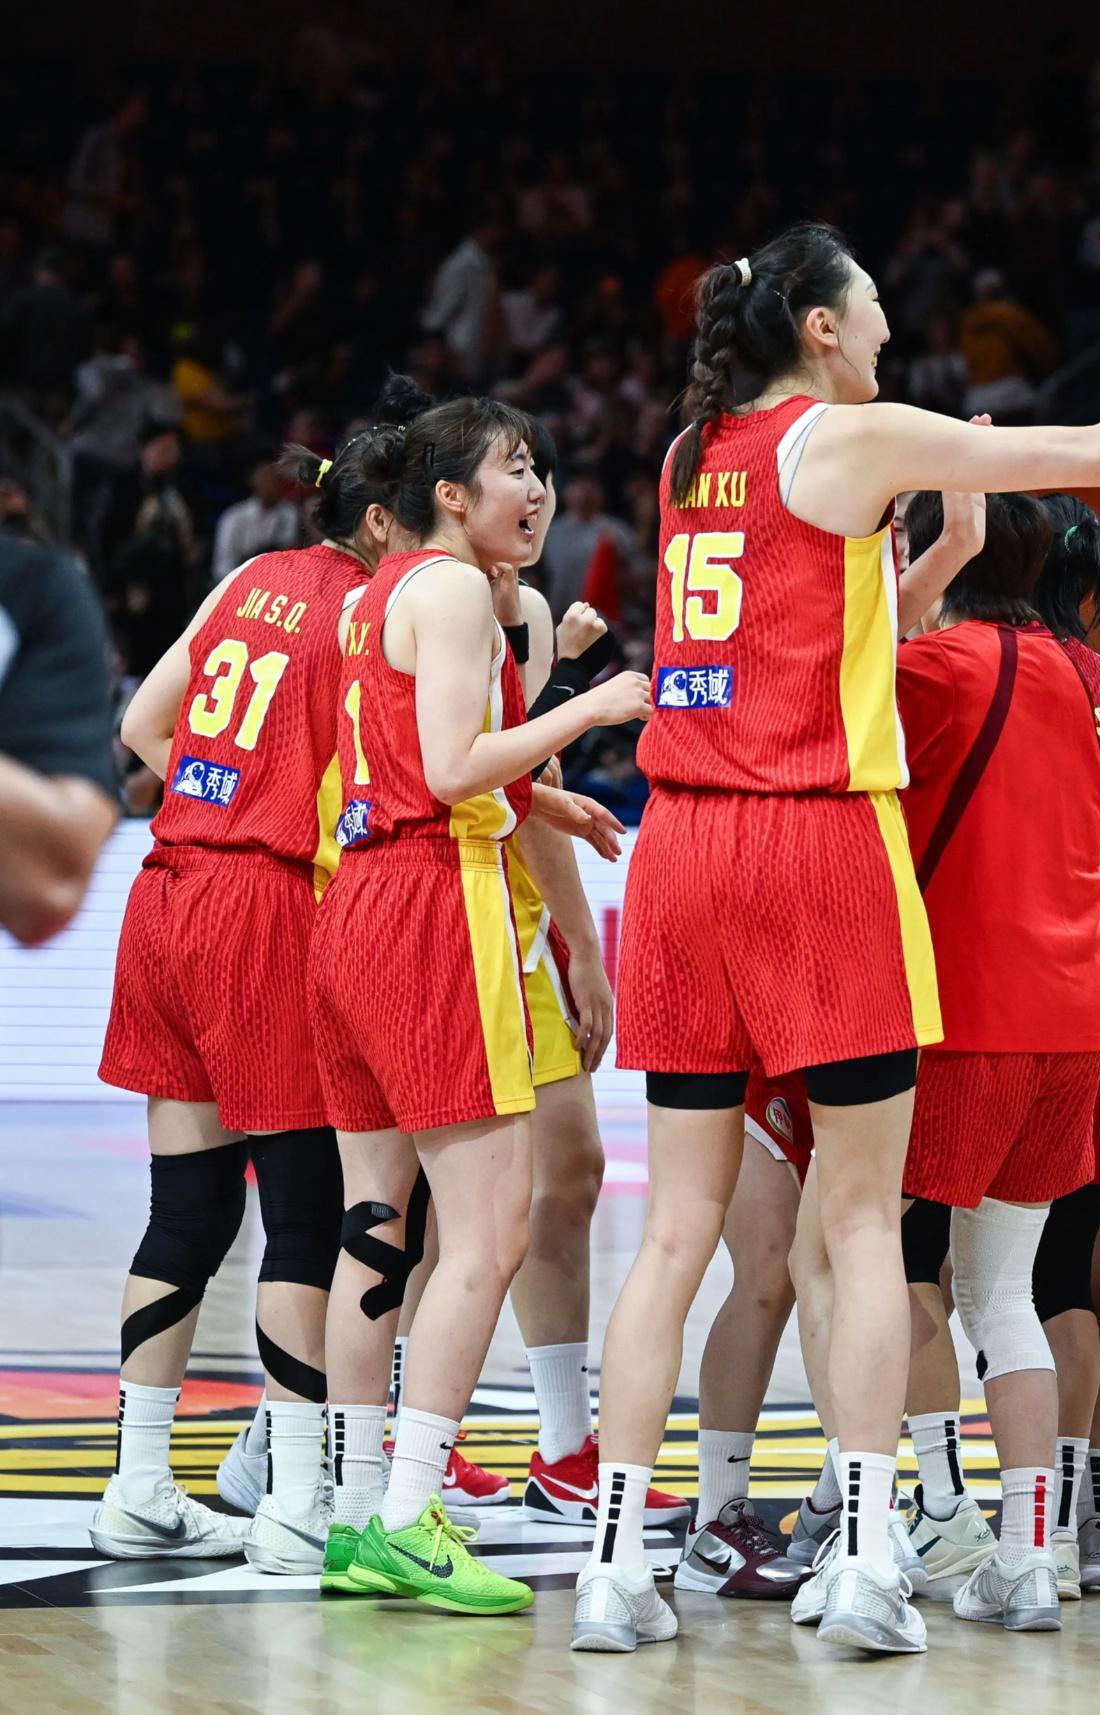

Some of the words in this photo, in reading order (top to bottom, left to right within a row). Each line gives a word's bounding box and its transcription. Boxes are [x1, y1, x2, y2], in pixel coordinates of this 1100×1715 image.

[715, 471, 747, 507] XU
[664, 531, 744, 642] 15
[236, 587, 271, 619] JIA
[264, 594, 307, 634] S.Q.
[188, 638, 290, 751] 31
[689, 668, 729, 705] 秀域
[203, 766, 238, 804] 秀域
